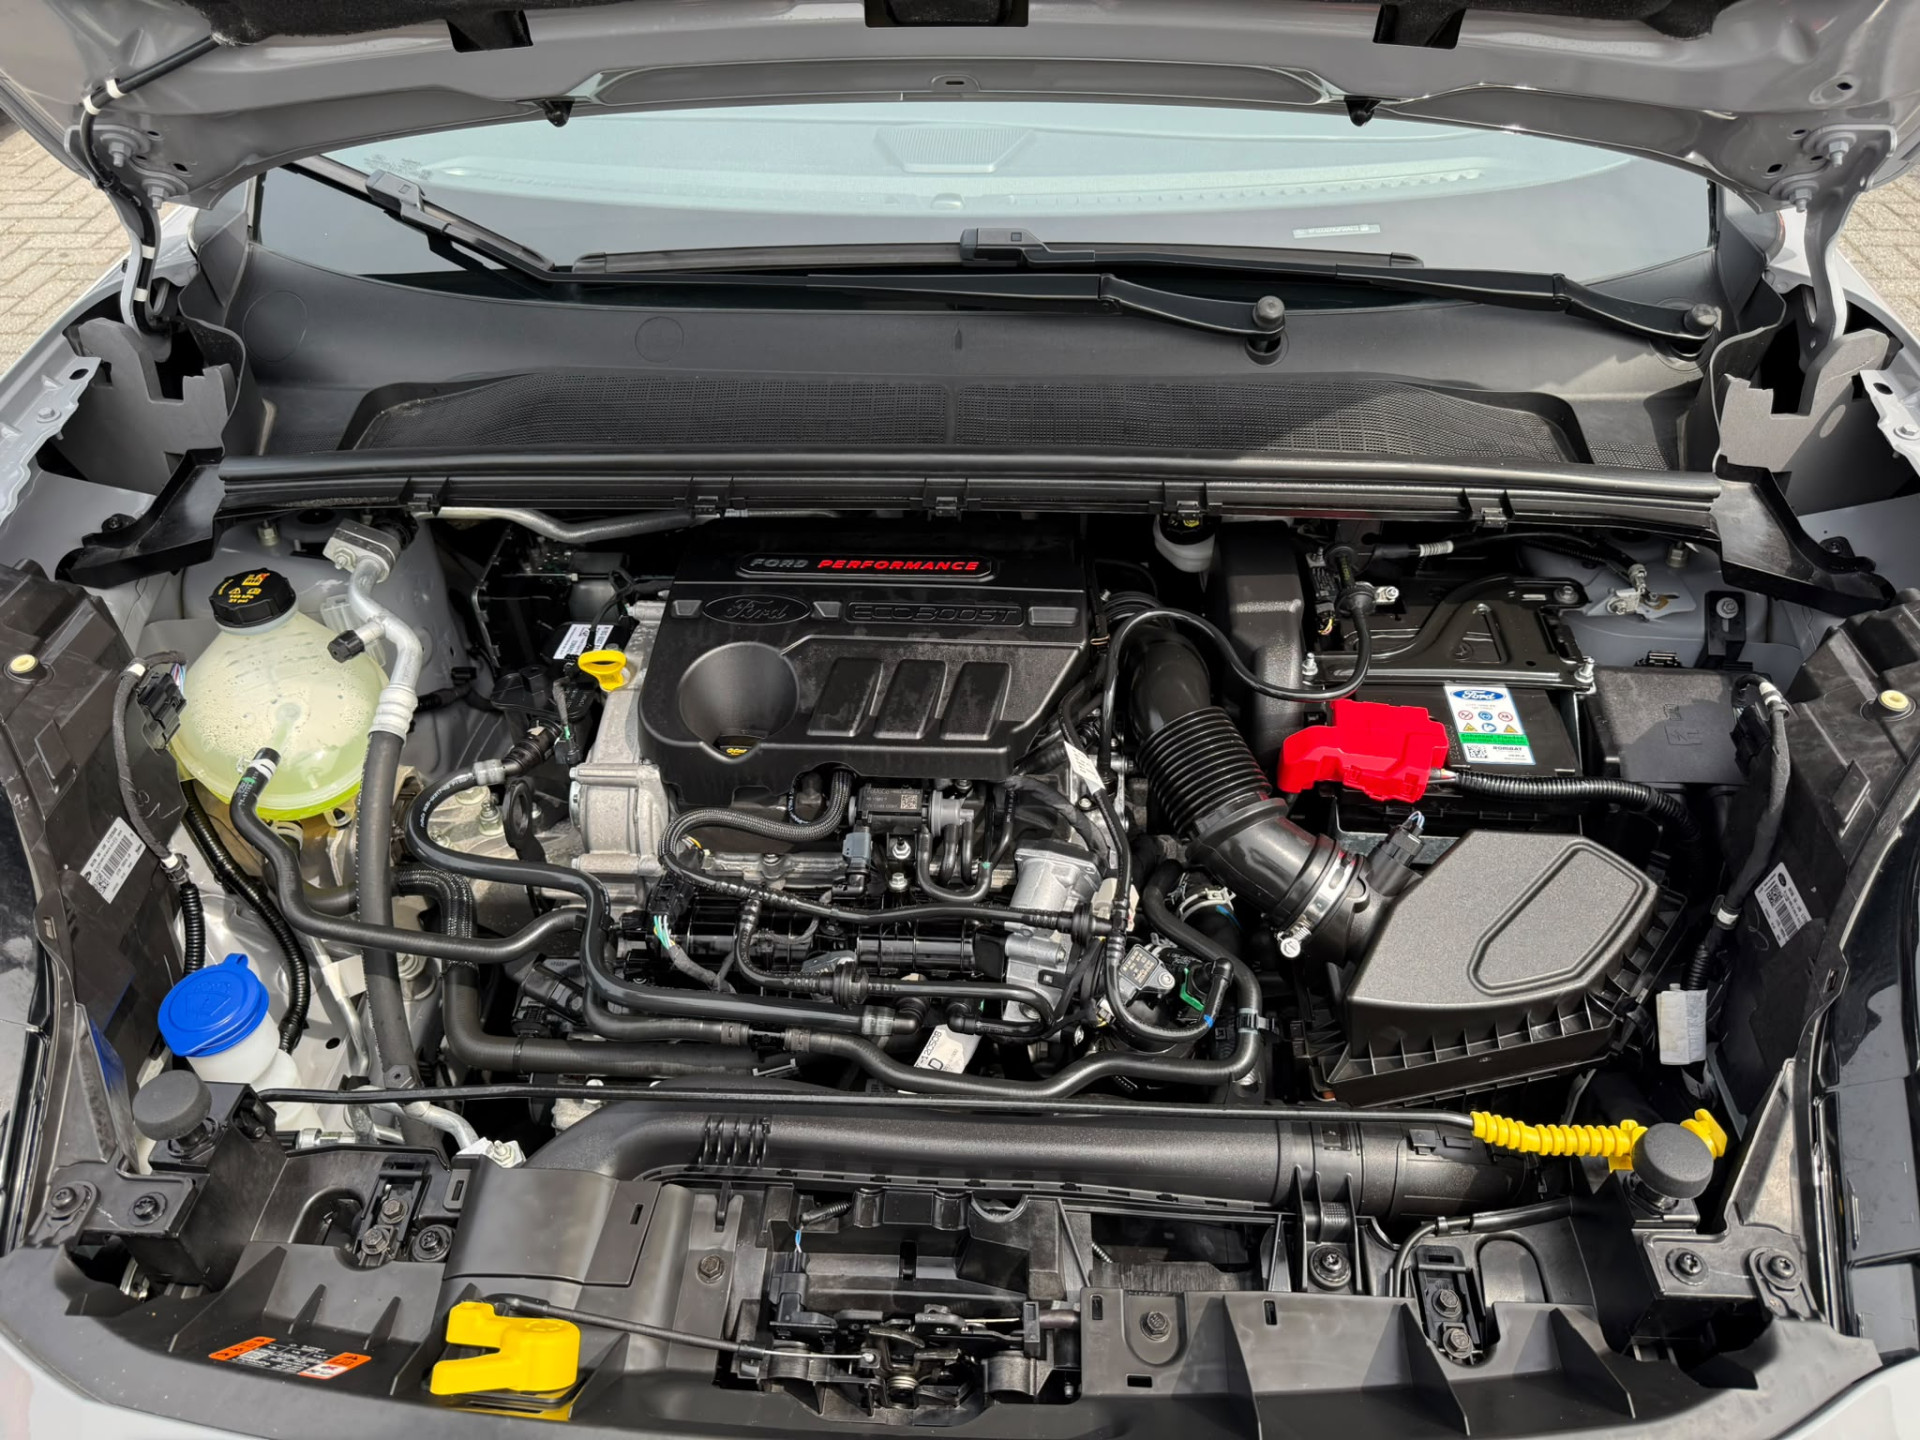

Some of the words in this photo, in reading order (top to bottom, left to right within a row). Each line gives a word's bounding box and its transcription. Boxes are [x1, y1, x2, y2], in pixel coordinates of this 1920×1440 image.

[749, 558, 809, 568] FORD
[817, 559, 980, 570] PERFORMANCE
[724, 599, 789, 619] Ford
[852, 605, 1017, 623] ECOBOOST
[1462, 689, 1496, 701] Ford
